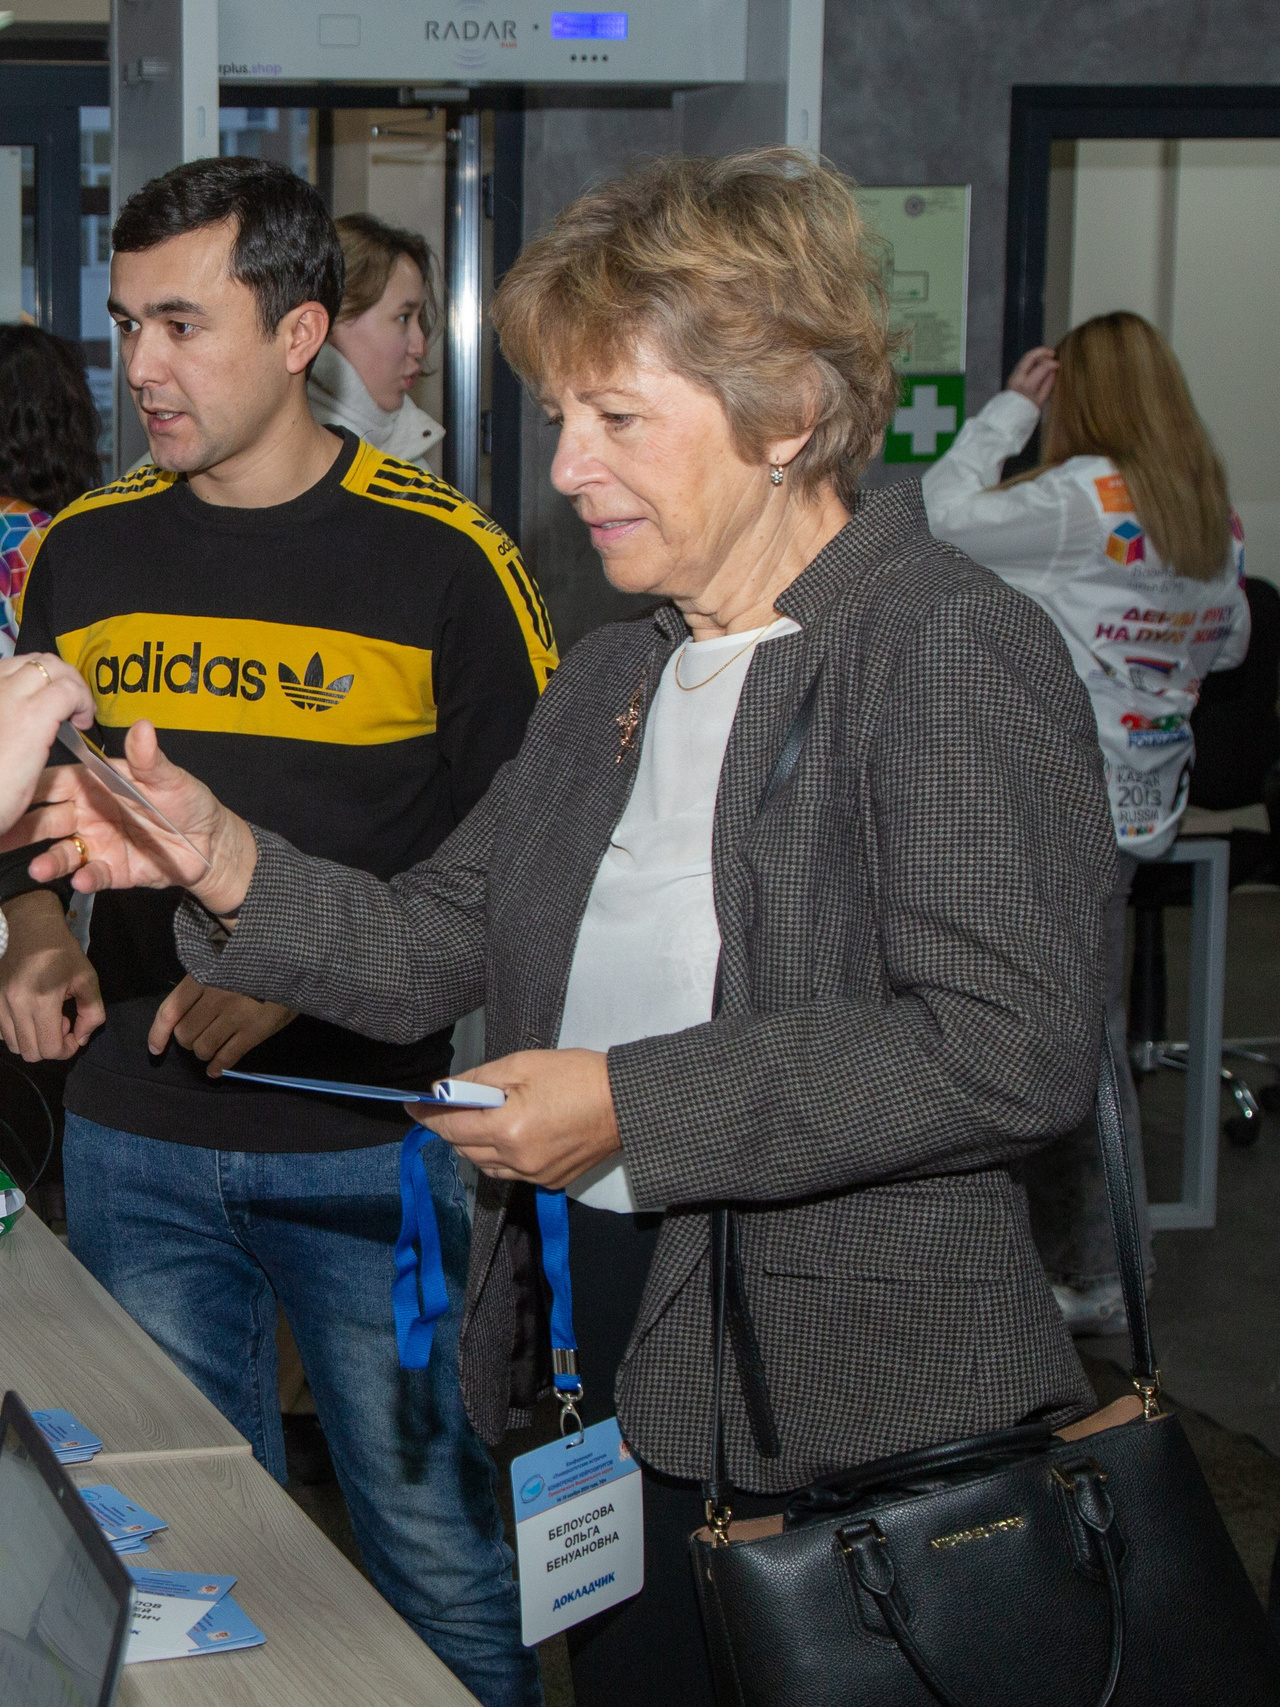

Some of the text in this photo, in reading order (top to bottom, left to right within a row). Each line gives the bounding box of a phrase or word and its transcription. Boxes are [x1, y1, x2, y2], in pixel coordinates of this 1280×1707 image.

[426, 20, 517, 41] RADAR
[219, 62, 282, 76] rplus.shop
[1095, 623, 1129, 640] НА
[96, 641, 267, 701] adidas
[1118, 785, 1161, 806] 2013
[1120, 809, 1160, 823] RUSSIA
[548, 1503, 615, 1541] БЕЛОУСОВА
[564, 1525, 600, 1549] ОЛЬГА
[546, 1531, 620, 1573] БЕНУАНОВНА
[552, 1571, 615, 1612] ДОКЛАДЧИК
